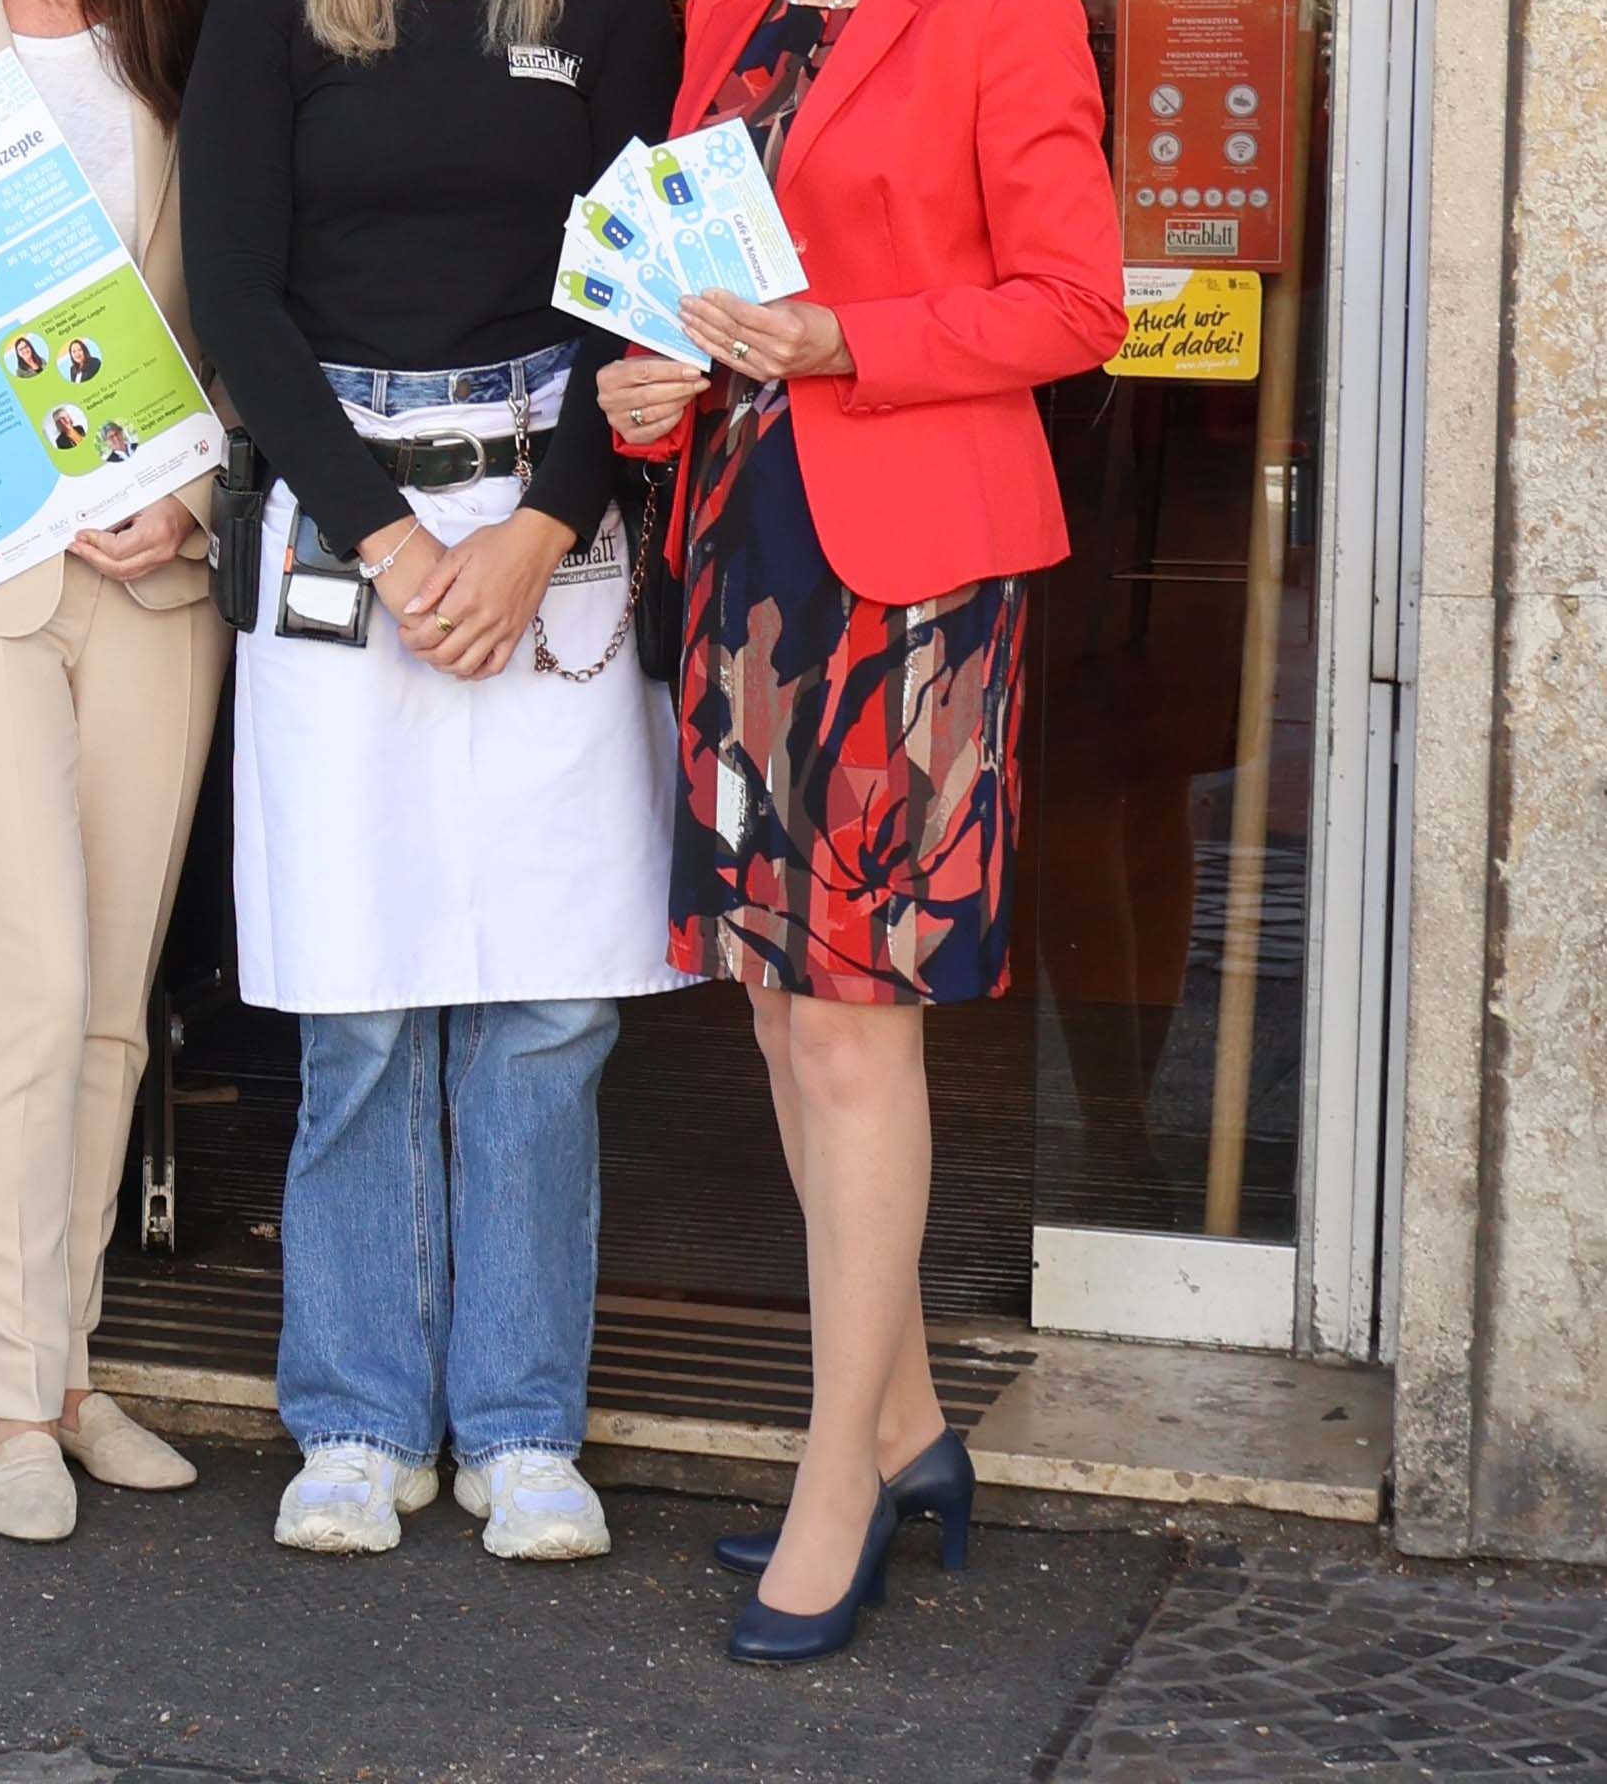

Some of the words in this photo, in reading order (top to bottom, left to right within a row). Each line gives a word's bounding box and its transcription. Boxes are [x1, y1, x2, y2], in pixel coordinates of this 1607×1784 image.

[1167, 222, 1232, 246] extrablatt
[733, 214, 747, 236] Café
[747, 244, 770, 291] Konzepte
[1134, 303, 1186, 333] Auch
[1195, 304, 1230, 327] wir
[1120, 332, 1170, 359] sind
[1173, 331, 1244, 357] dabei!
